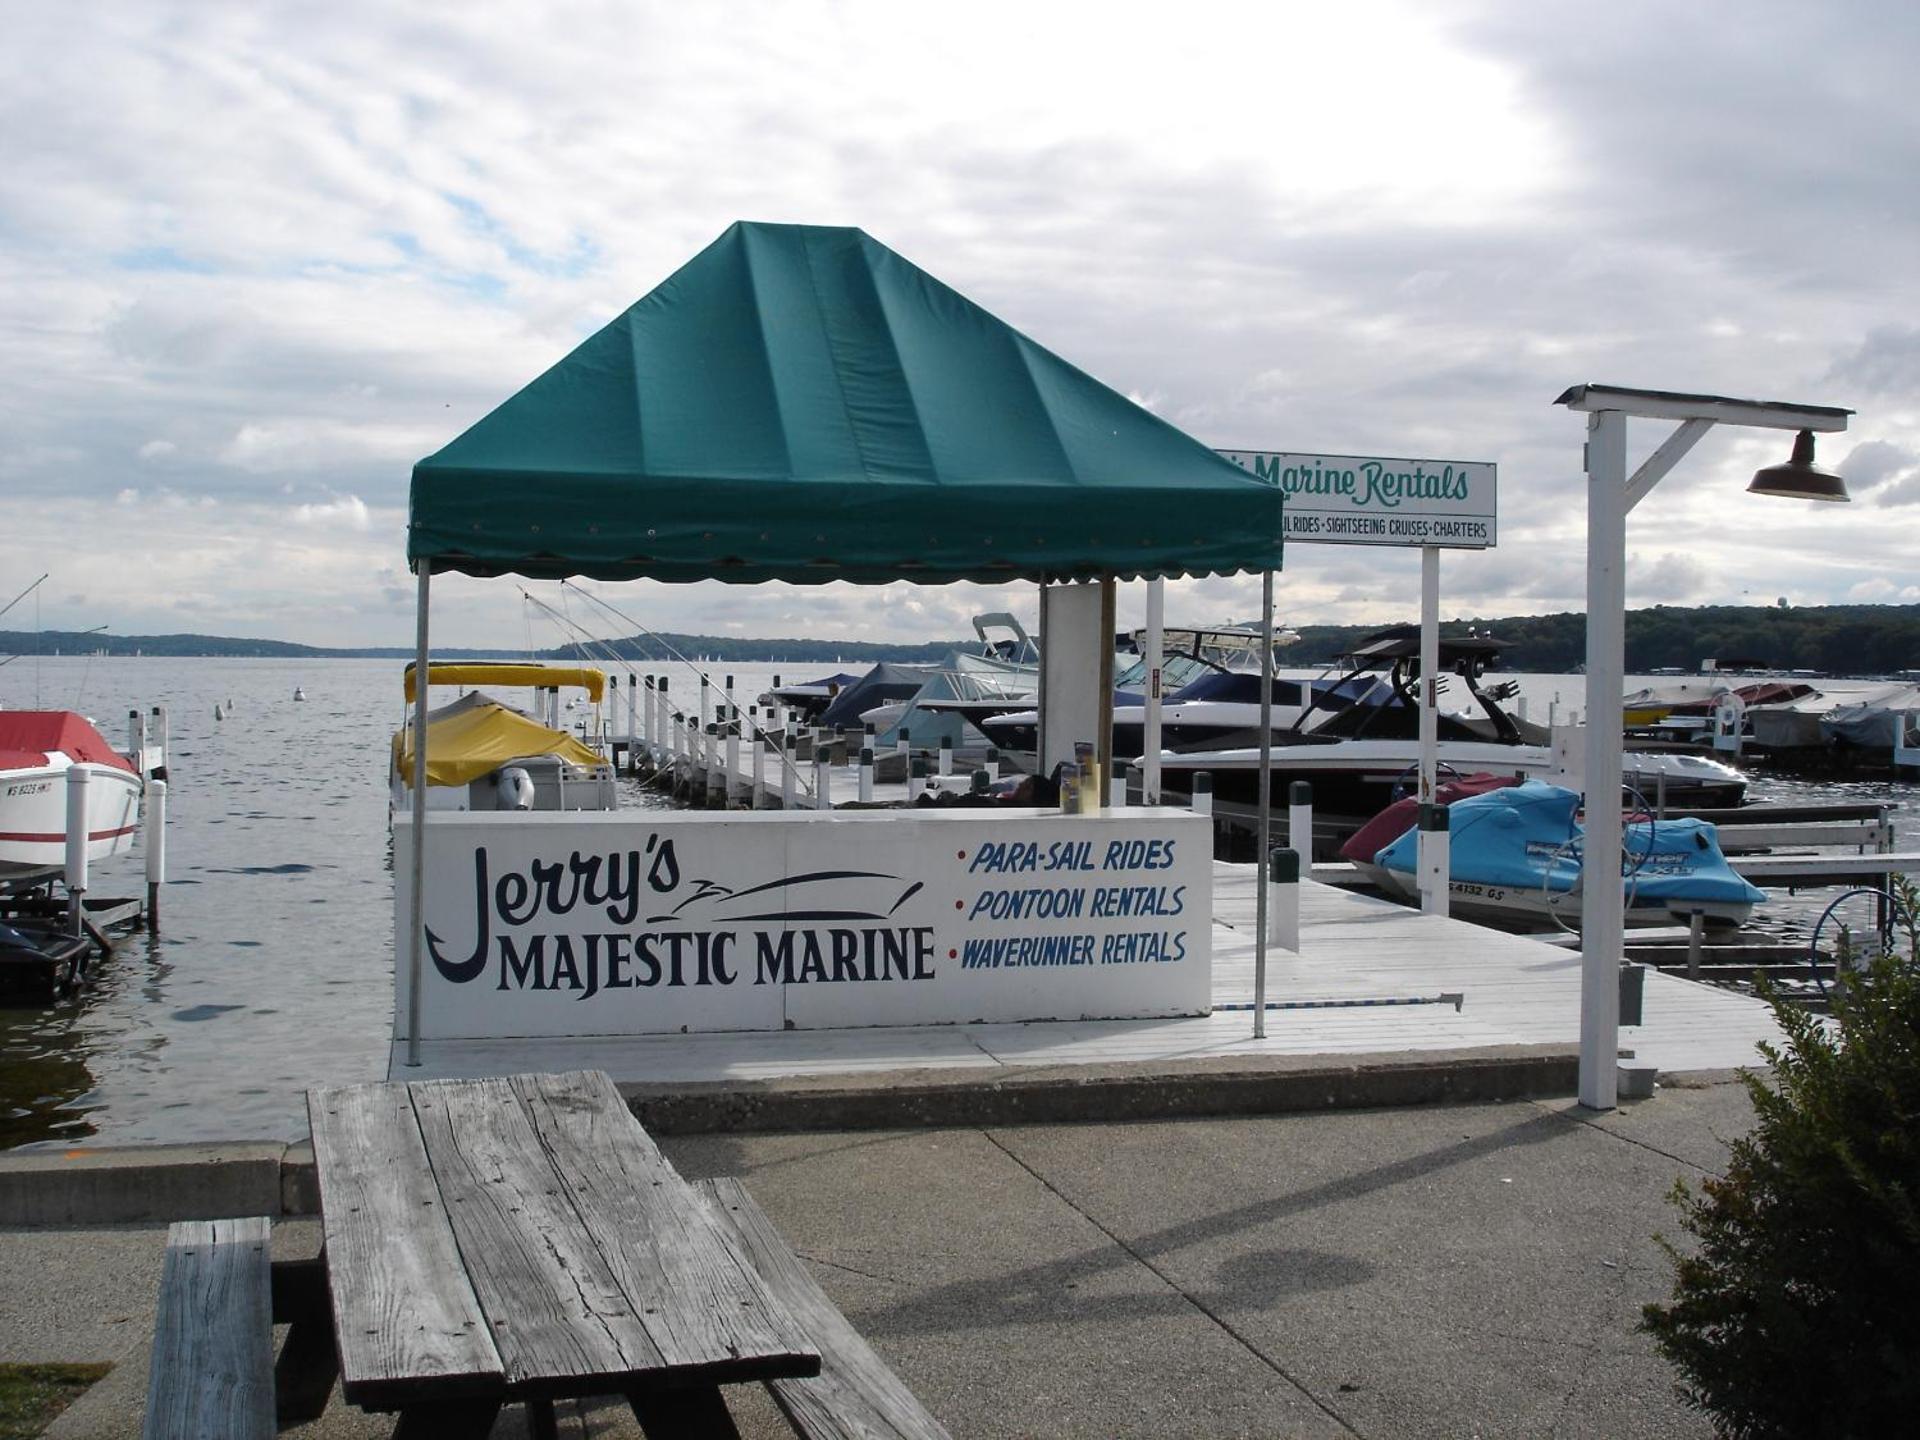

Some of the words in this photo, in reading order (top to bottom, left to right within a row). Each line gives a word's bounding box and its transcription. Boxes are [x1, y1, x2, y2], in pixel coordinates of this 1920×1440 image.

[1255, 455, 1356, 500] Marine
[1351, 461, 1468, 508] Rentals
[1293, 517, 1320, 533] RIDES
[1326, 517, 1386, 535] SIGHTSEEING
[1389, 519, 1428, 536] CRUISES
[1433, 521, 1487, 538] CHARTERS
[968, 841, 1095, 873] PARA-SAIL
[1102, 840, 1176, 870] RIDES
[424, 833, 680, 983] Jerry's
[968, 888, 1086, 920] PONTOON
[1090, 885, 1187, 917] RENTALS
[496, 931, 737, 1000] MAJESTIC
[753, 926, 936, 985] MARINE
[961, 934, 1095, 969] WAVERUNNER
[1100, 931, 1187, 964] RENTALS
